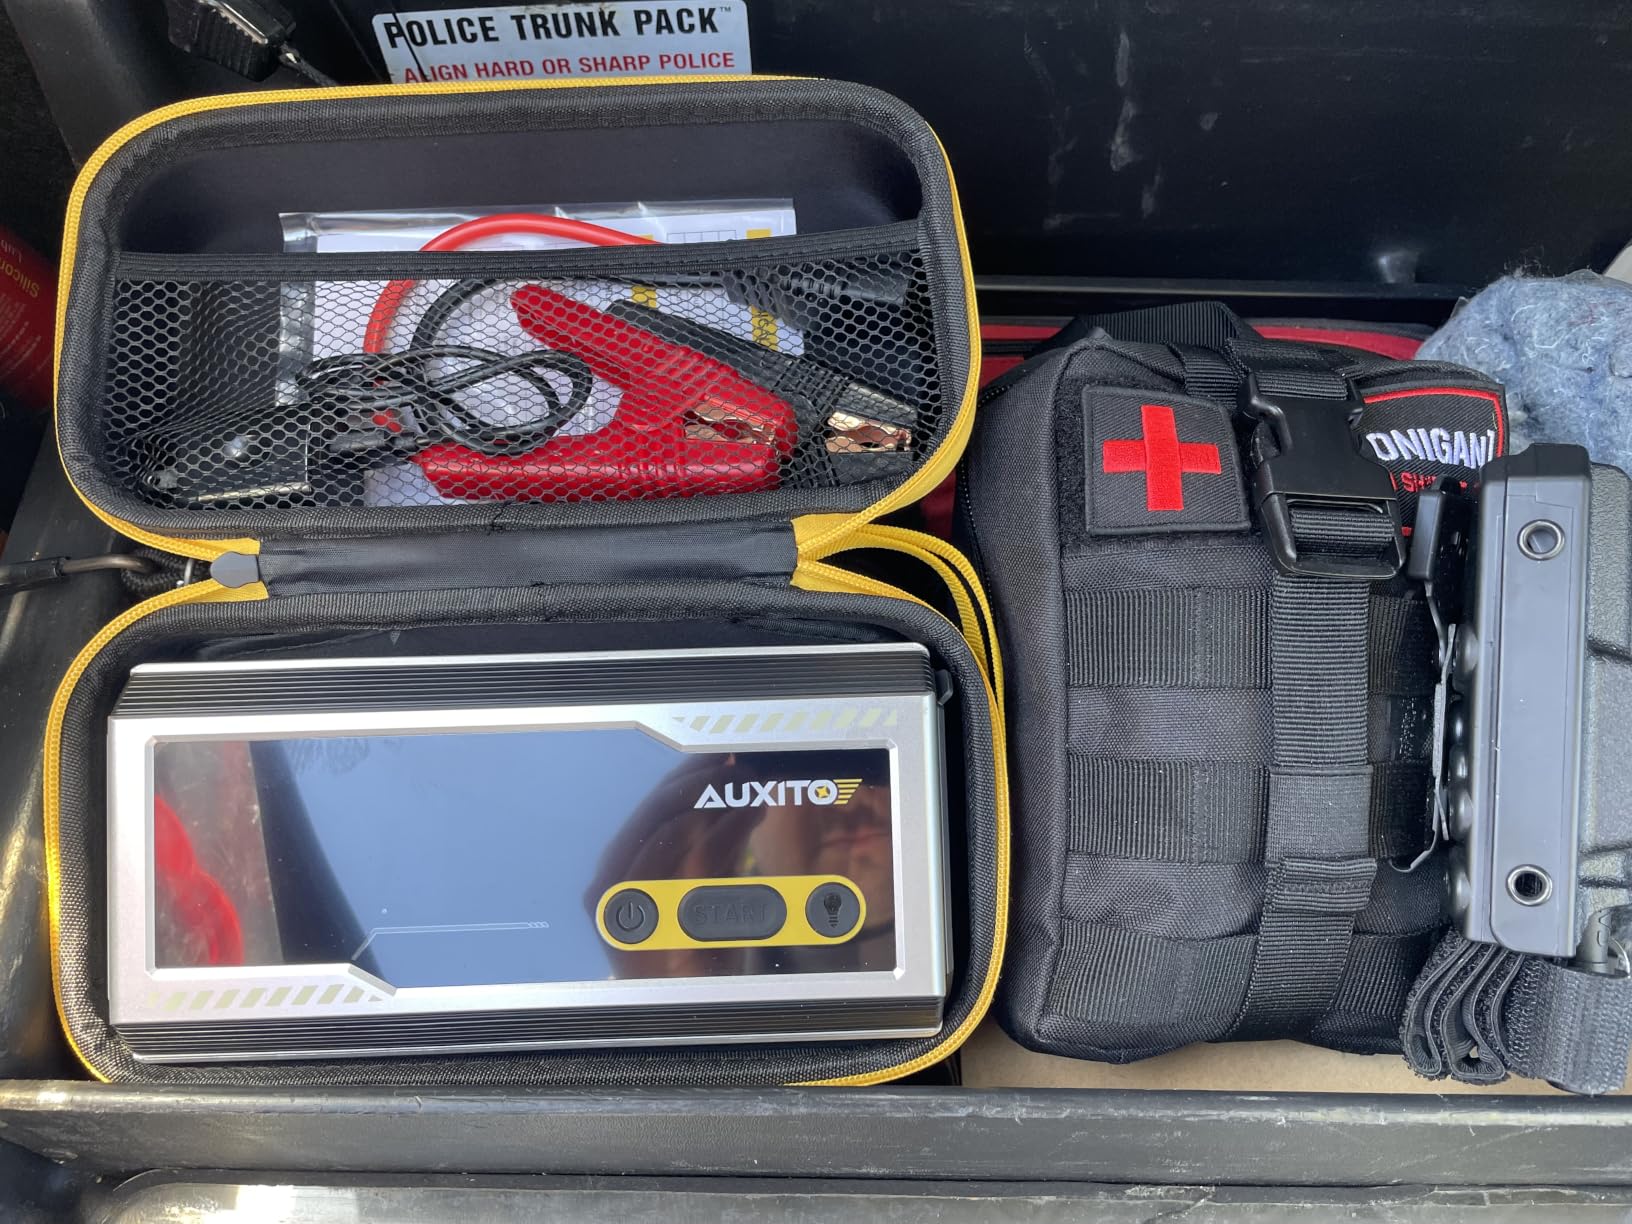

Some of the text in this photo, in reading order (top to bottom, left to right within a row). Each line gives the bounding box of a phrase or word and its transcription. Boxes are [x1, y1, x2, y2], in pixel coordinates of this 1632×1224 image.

[383, 16, 500, 48] POLICE
[510, 10, 621, 41] TRUNK
[474, 59, 535, 79] HARD
[541, 57, 573, 75] OR
[579, 54, 651, 74] SHARP
[658, 52, 736, 70] POLICE
[693, 778, 838, 809] AUXITO
[693, 902, 769, 926] START
